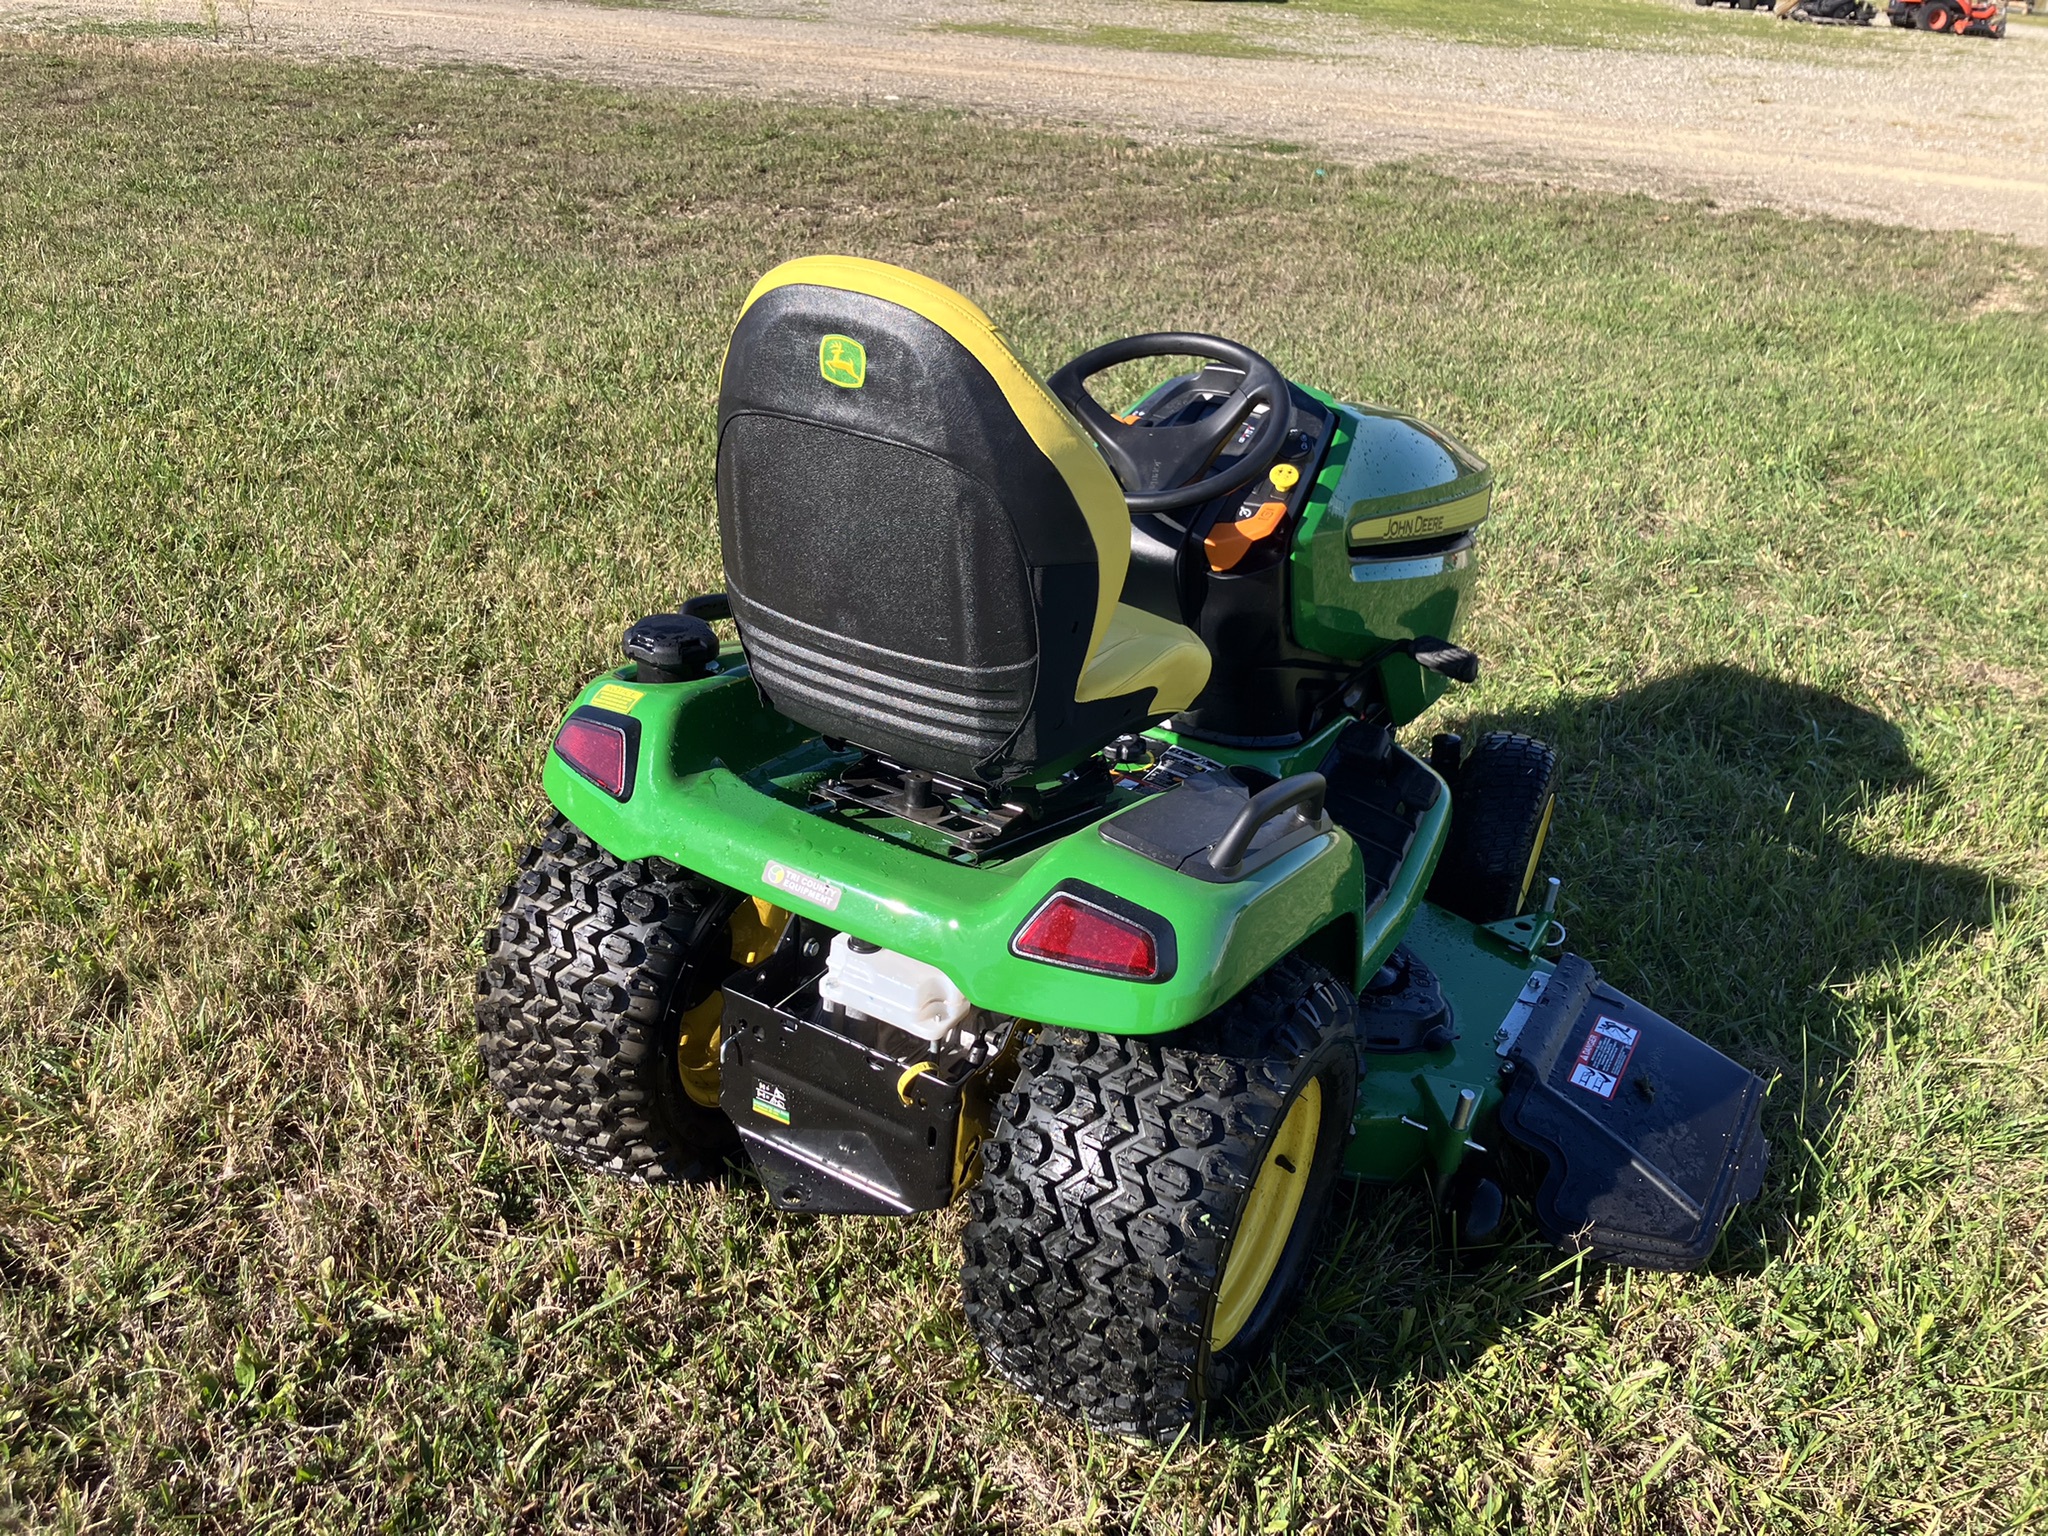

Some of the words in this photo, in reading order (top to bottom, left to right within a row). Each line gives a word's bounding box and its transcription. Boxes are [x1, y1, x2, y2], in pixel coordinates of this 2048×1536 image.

[1383, 518, 1413, 537] JOHN
[1414, 516, 1444, 533] DEERE
[783, 880, 834, 906] EQUIPMENT
[785, 870, 800, 881] TRI
[801, 877, 837, 898] COUNTY
[1583, 1034, 1598, 1057] DANGER
